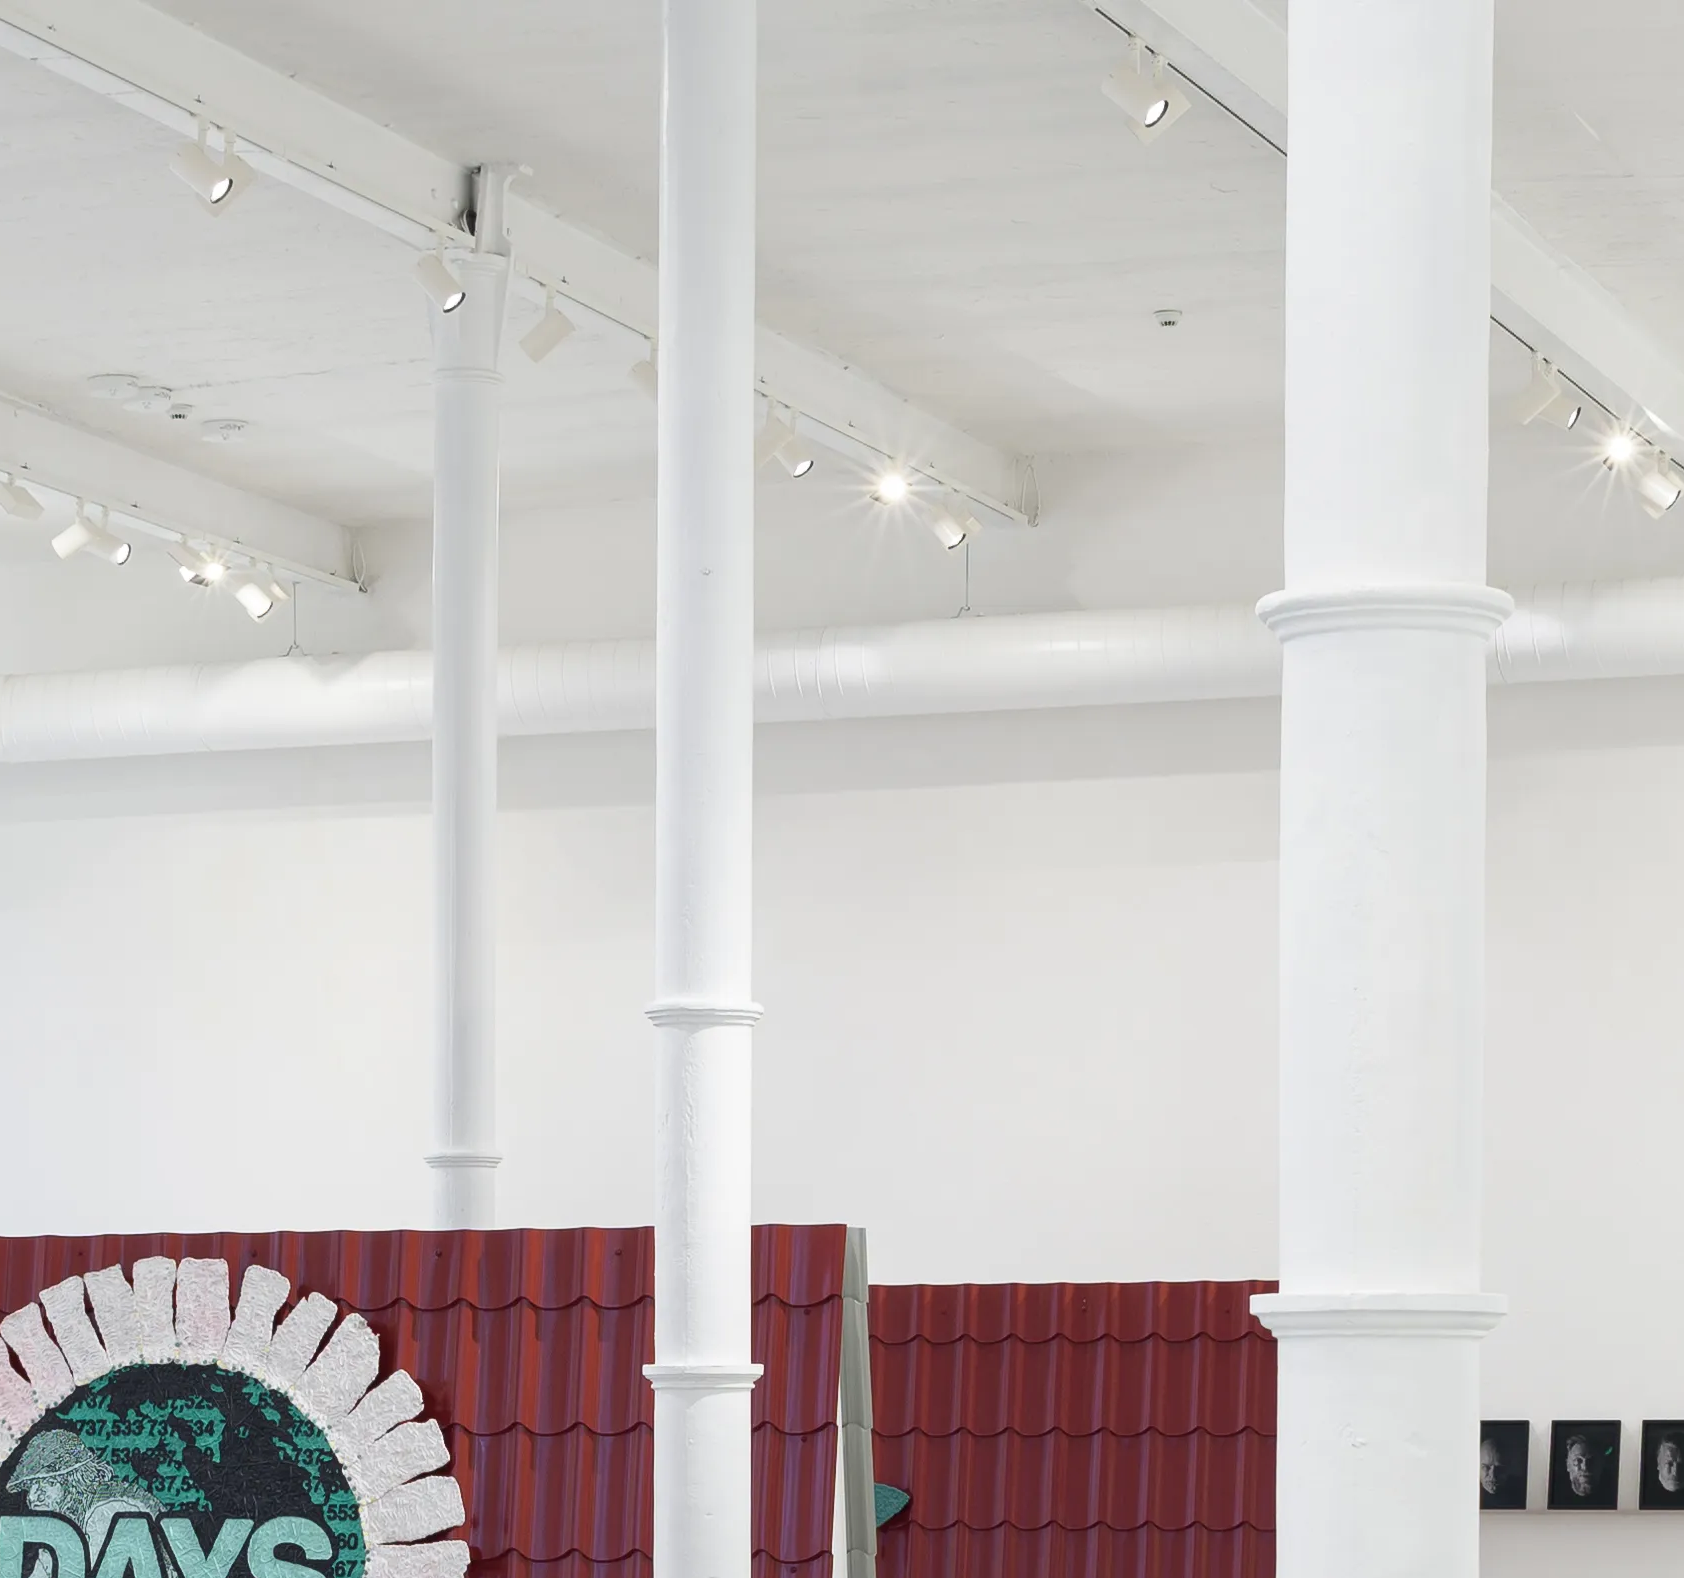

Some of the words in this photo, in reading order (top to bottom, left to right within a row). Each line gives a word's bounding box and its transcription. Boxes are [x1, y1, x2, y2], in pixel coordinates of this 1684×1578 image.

[75, 1419, 144, 1441] 737,533
[327, 1504, 359, 1521] 553
[335, 1560, 358, 1577] 67
